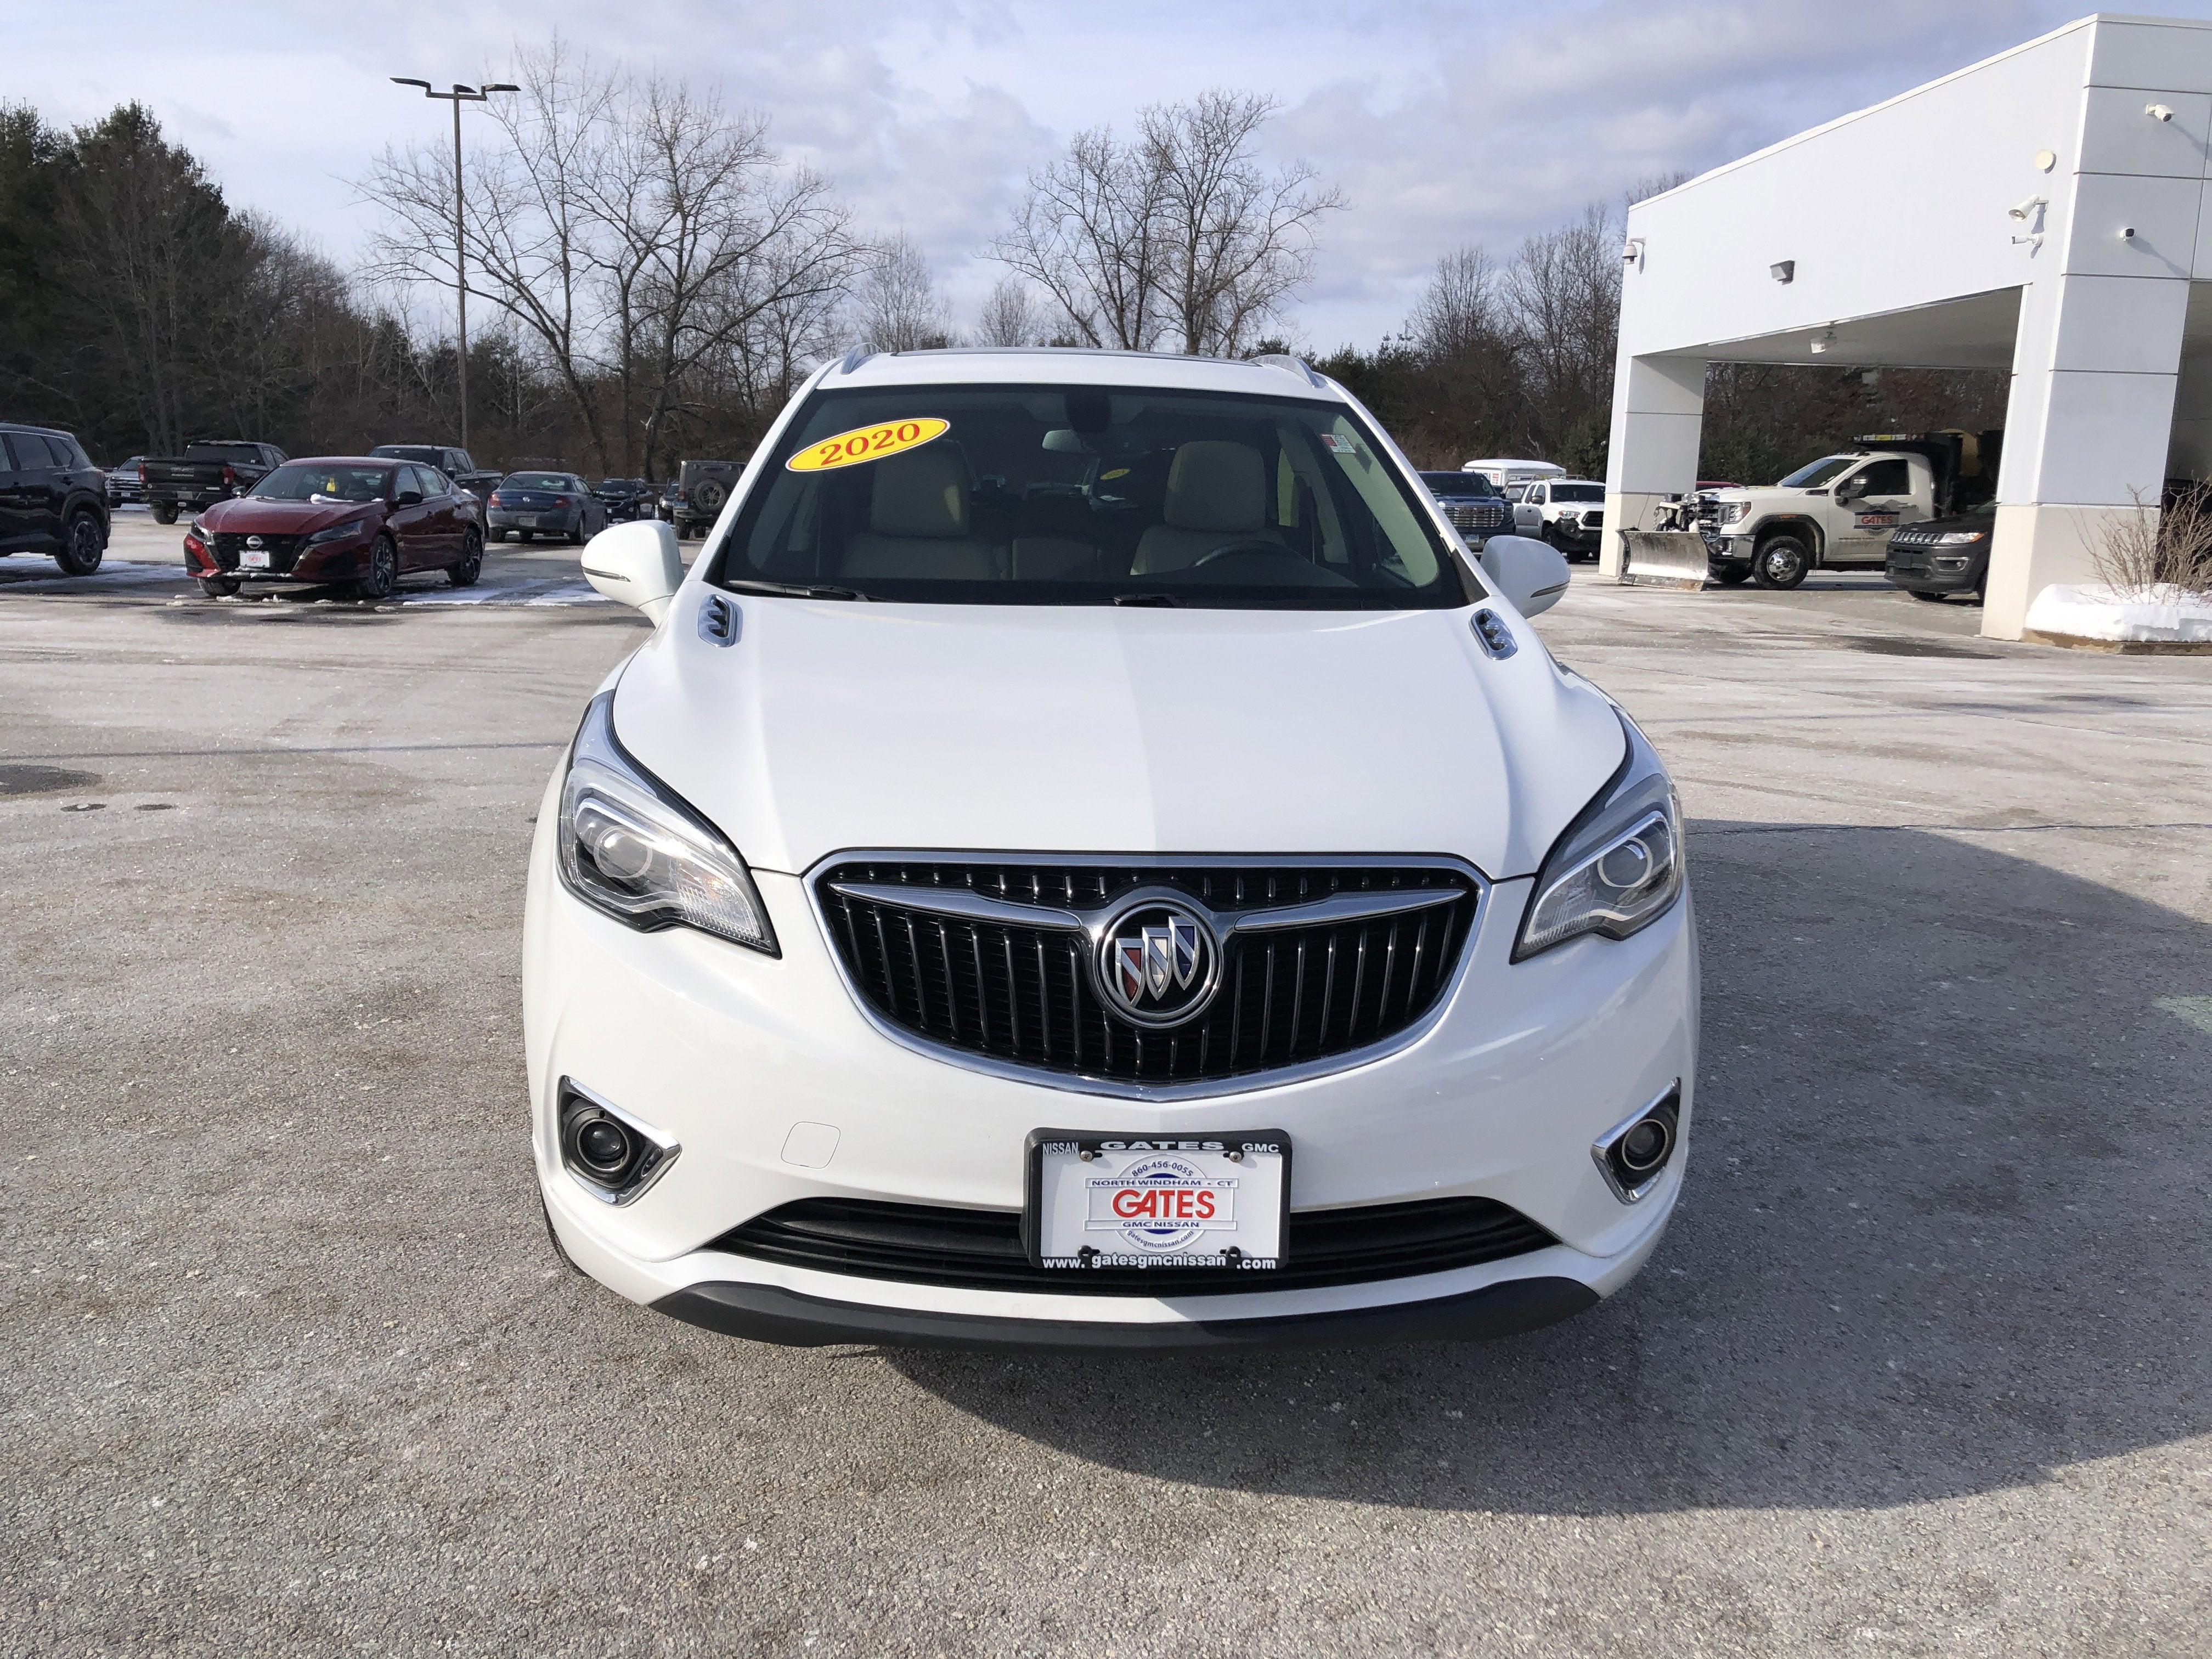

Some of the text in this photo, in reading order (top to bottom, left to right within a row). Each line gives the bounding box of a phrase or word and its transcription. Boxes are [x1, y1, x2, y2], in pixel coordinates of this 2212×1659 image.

[820, 424, 919, 466] 2020
[1861, 516, 1893, 524] GATES
[1043, 1142, 1279, 1155] NISSAN GATES GMC
[1131, 1161, 1194, 1177] 860-456-0055
[1112, 1189, 1215, 1219] GATES
[1127, 1229, 1194, 1248] gatesgmcnissan.com
